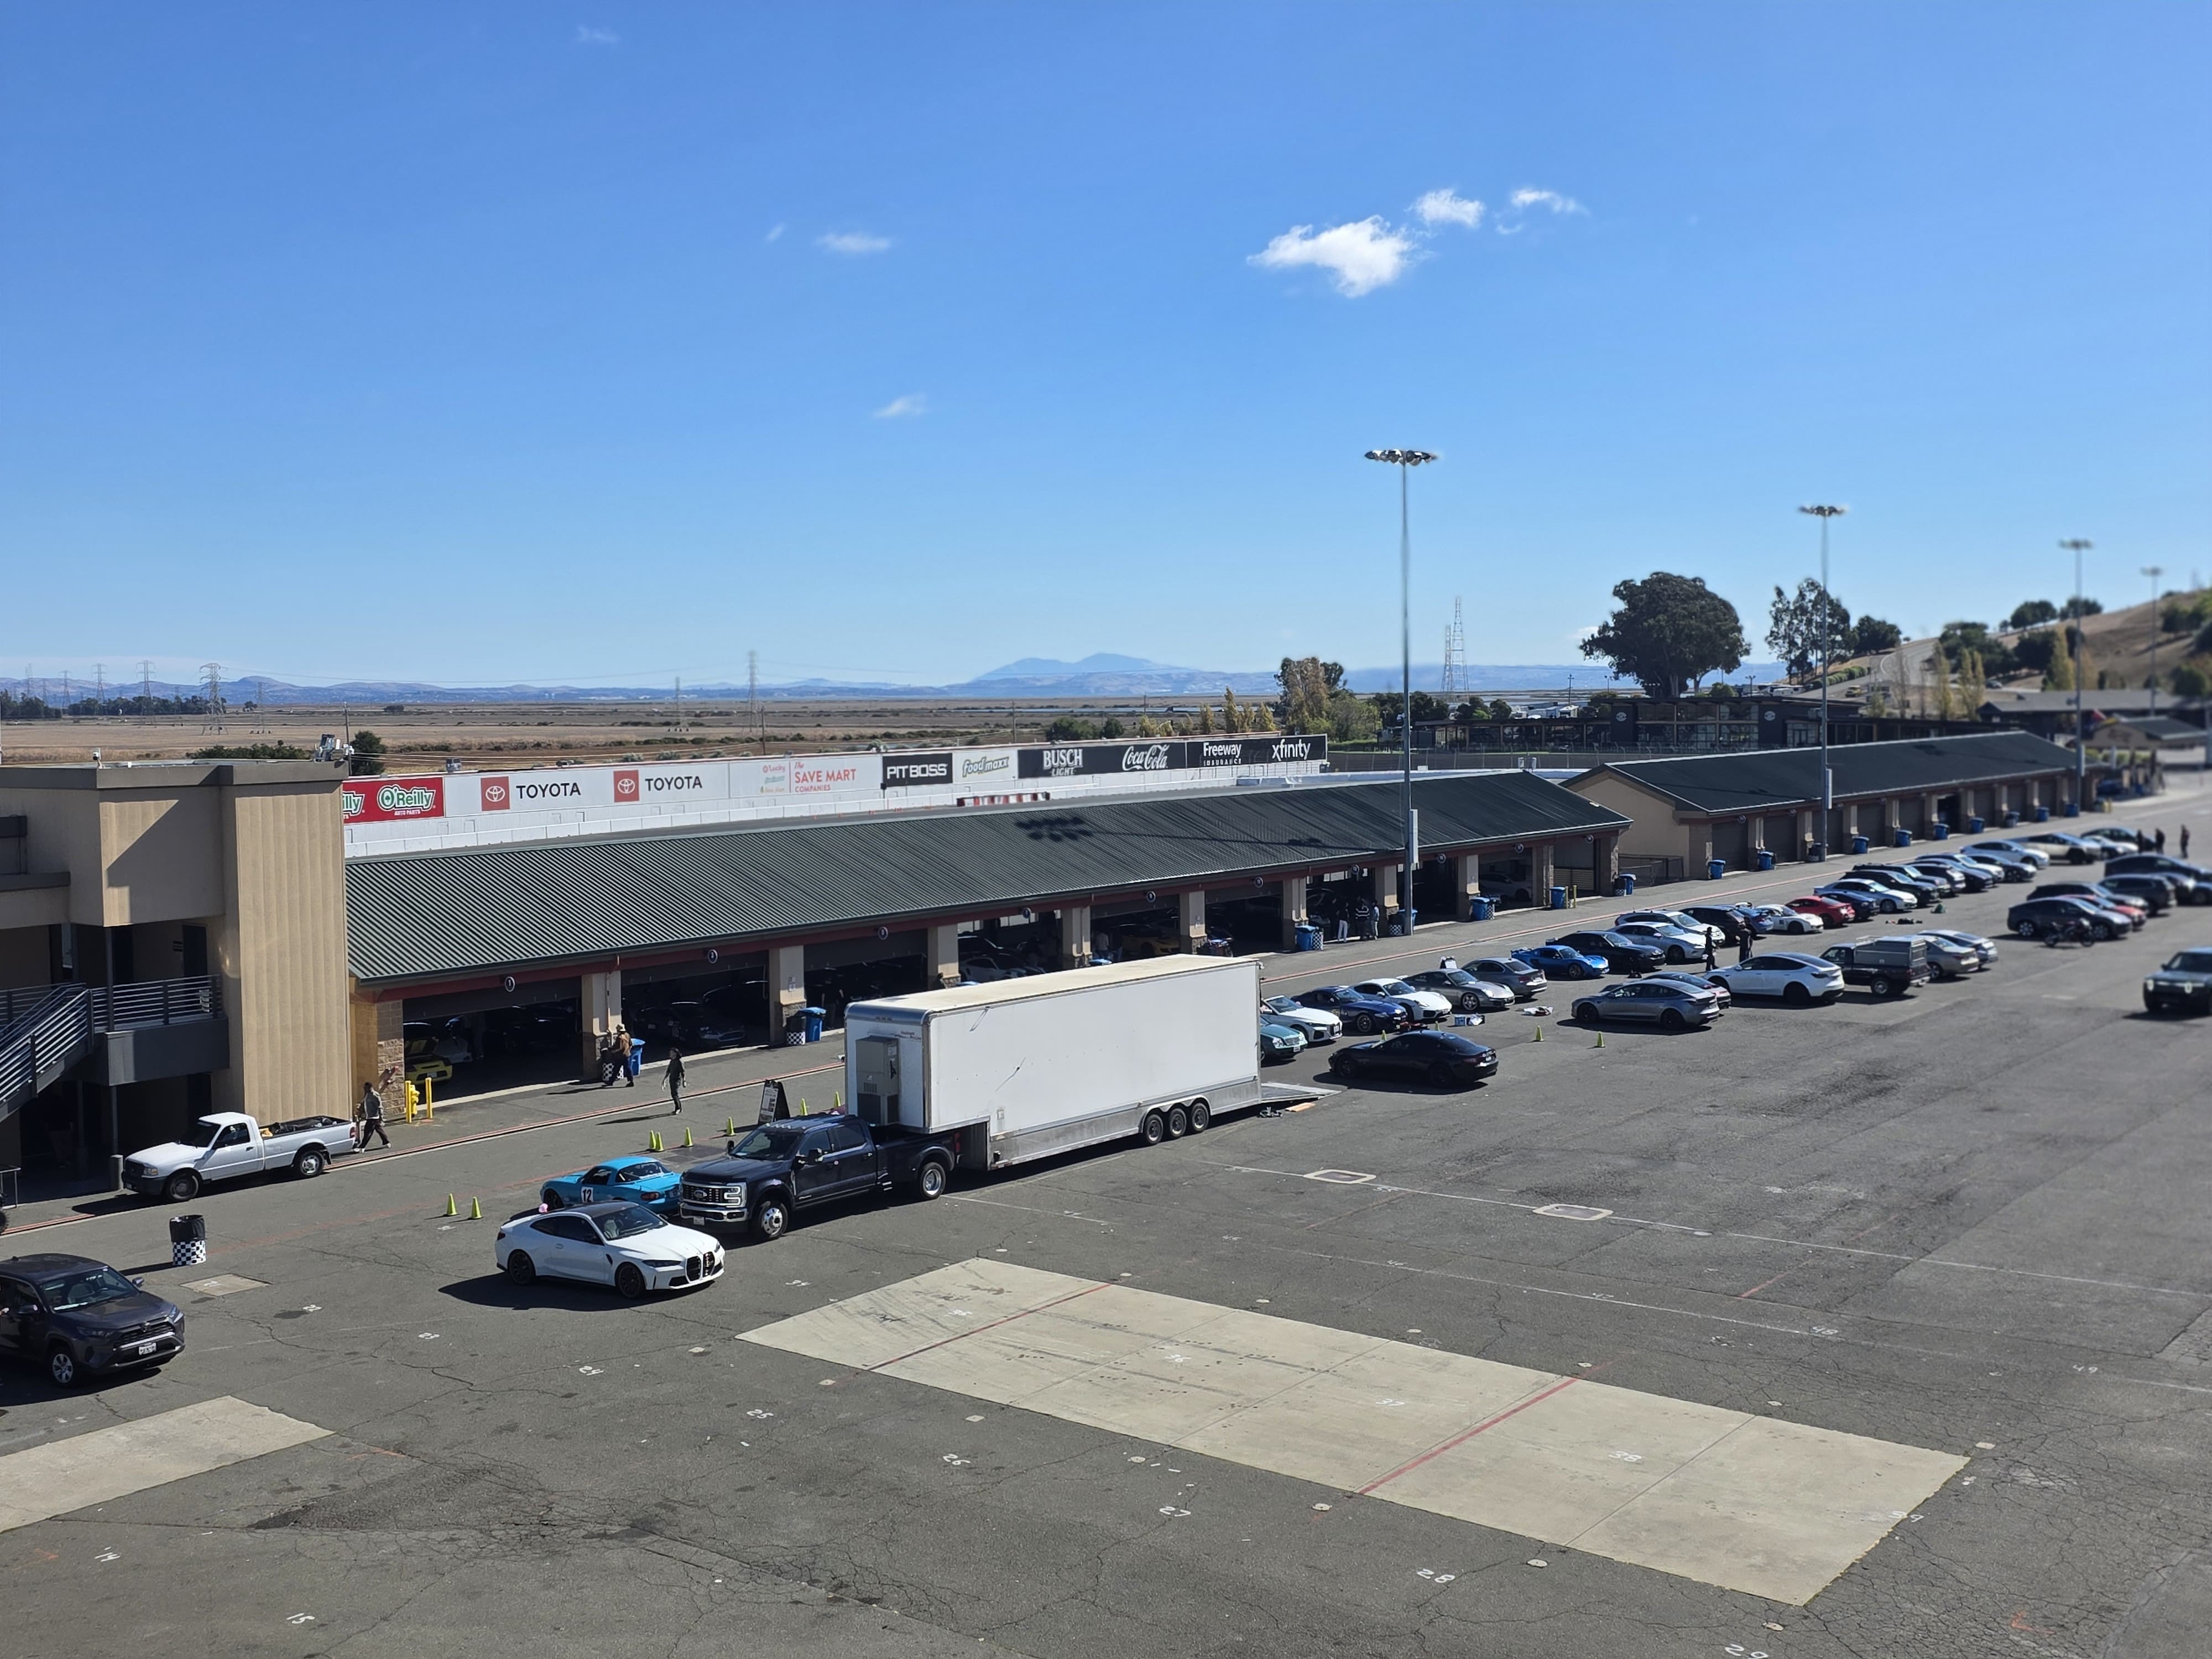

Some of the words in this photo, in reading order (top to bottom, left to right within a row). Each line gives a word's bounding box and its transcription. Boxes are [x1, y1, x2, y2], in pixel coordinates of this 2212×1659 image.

[1203, 742, 1241, 758] Freeway
[1272, 739, 1311, 761] xfinity
[1043, 749, 1083, 770] BUSCH
[795, 770, 822, 784] SAVE
[826, 769, 856, 782] MART
[1051, 767, 1074, 776] LIGHT
[645, 776, 703, 791] TOYOTA
[516, 782, 581, 799] TOYOTA
[380, 788, 434, 807] O'Reilly
[582, 1189, 592, 1203] 12
[1812, 1326, 1838, 1335] 48
[579, 1365, 604, 1376] 24
[2073, 1364, 2098, 1373] 49
[1375, 1398, 1405, 1406] 37
[747, 1409, 774, 1419] 25
[943, 1453, 971, 1465] 26
[1609, 1451, 1642, 1462] 38
[1159, 1506, 1192, 1517] 27
[1888, 1510, 1924, 1523] 39
[1417, 1568, 1455, 1583] 28
[286, 1613, 316, 1624] 15
